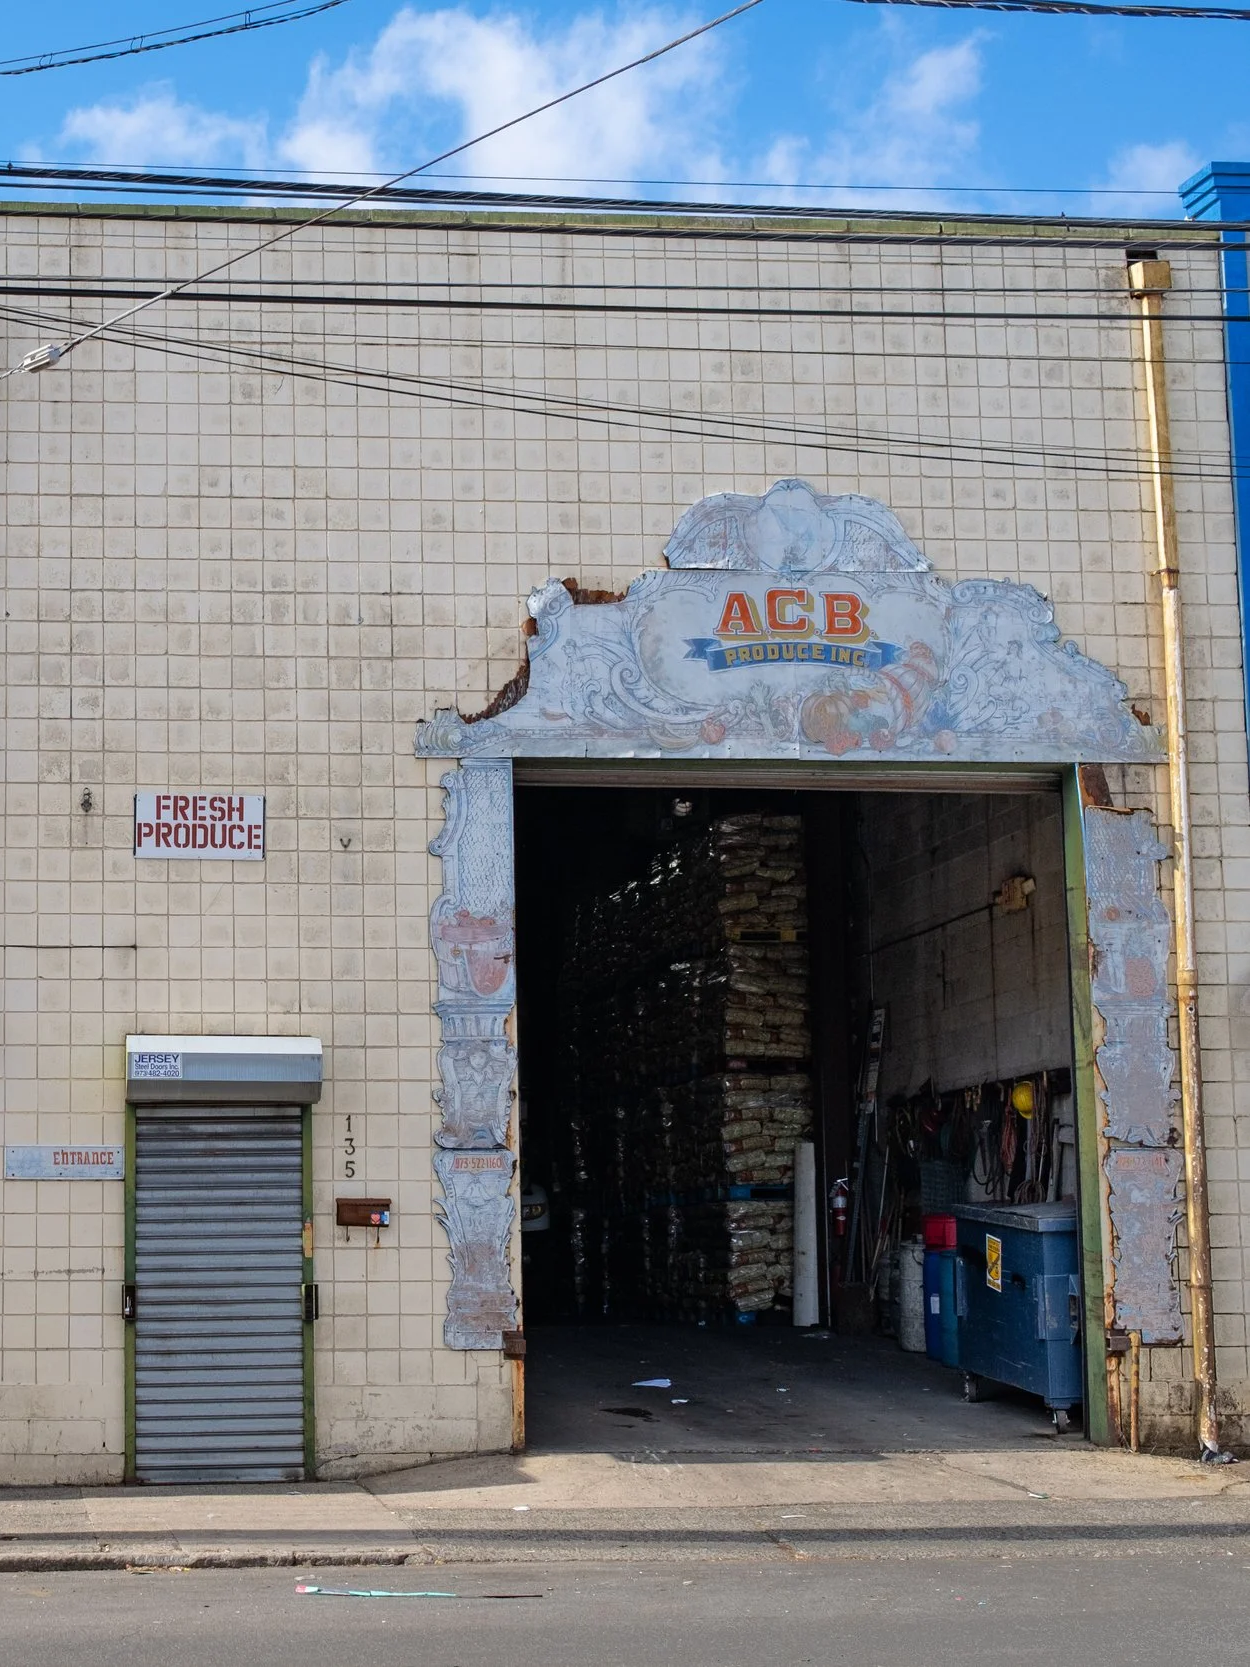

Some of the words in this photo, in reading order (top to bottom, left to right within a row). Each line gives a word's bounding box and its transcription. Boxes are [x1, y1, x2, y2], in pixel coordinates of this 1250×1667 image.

[724, 643, 826, 666] PRODUCE
[155, 795, 245, 821] FRESH
[137, 822, 262, 849] PRODUCE
[134, 1054, 179, 1063] JERSEY
[344, 1114, 356, 1178] 135
